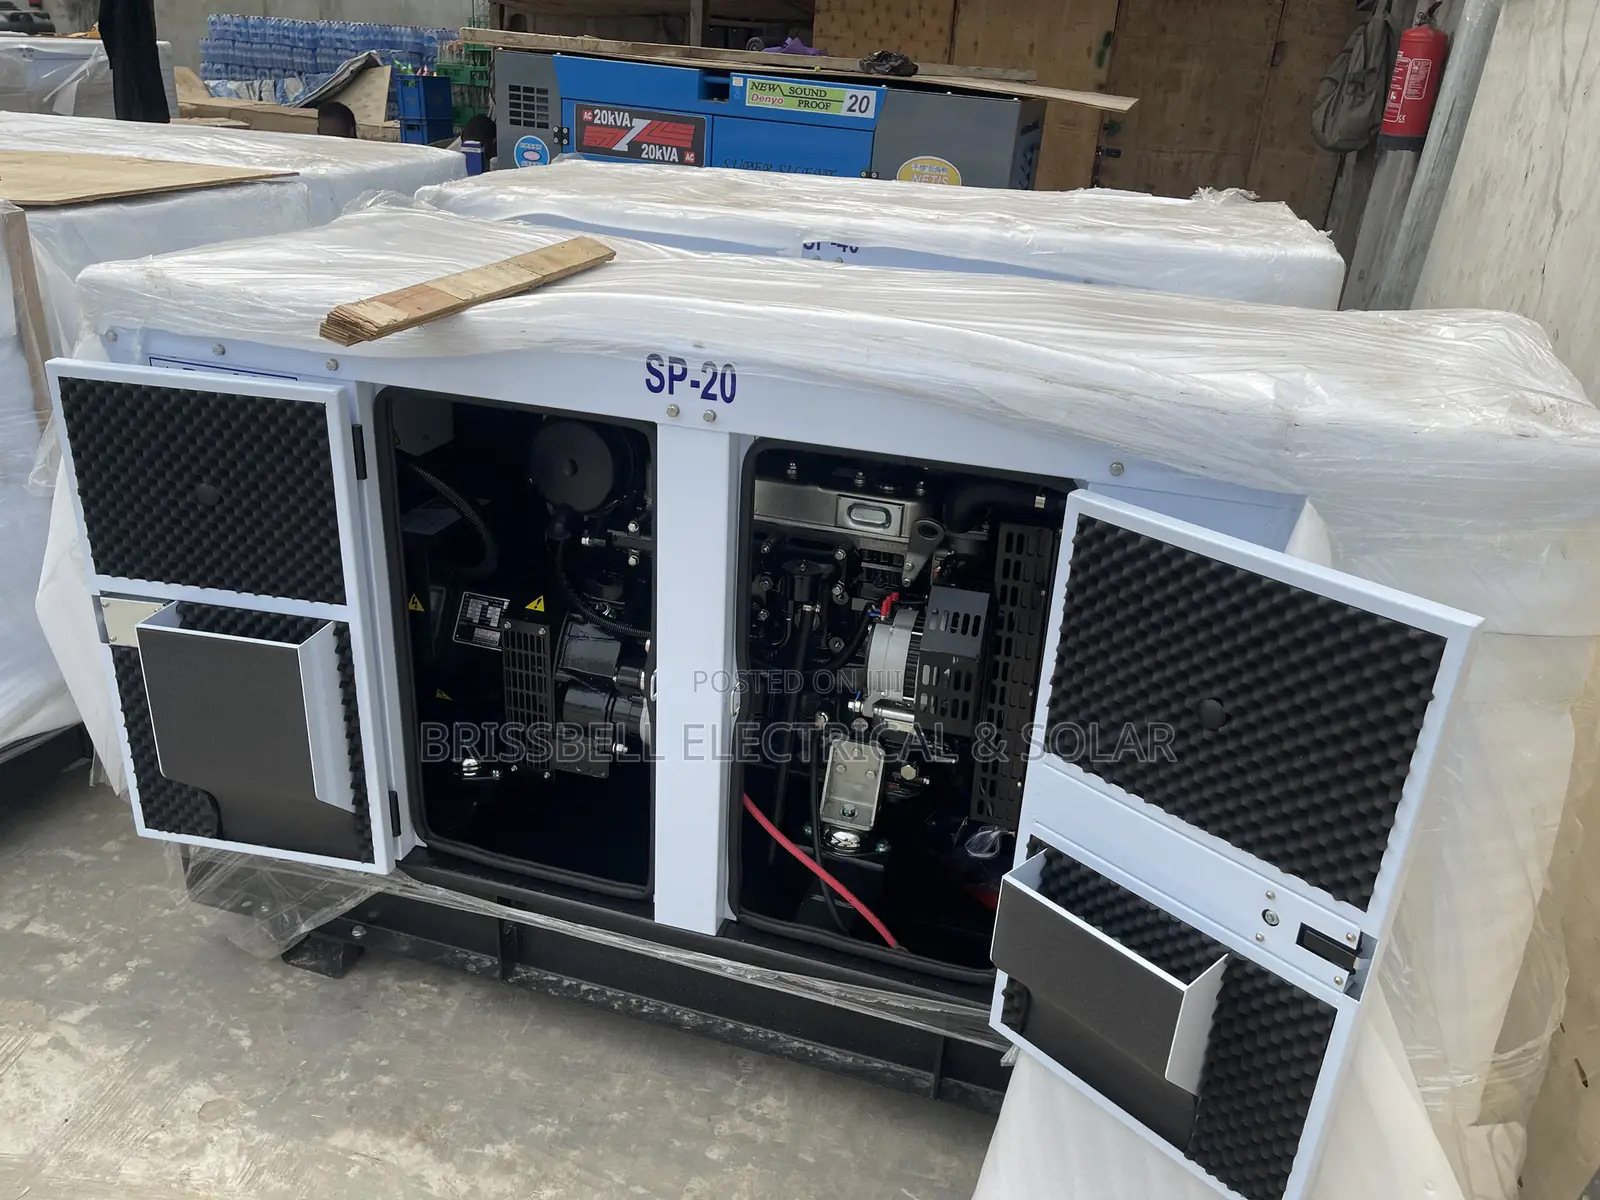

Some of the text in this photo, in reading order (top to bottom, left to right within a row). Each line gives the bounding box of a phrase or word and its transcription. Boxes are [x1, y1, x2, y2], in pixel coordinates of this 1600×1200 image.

[750, 82, 827, 98] NEW SOUND
[751, 93, 832, 110] Denyo PROOF
[846, 94, 871, 114] 20
[583, 108, 631, 128] AC 20kVA
[641, 143, 695, 163] 20kVA AC
[645, 353, 737, 404] SP-20
